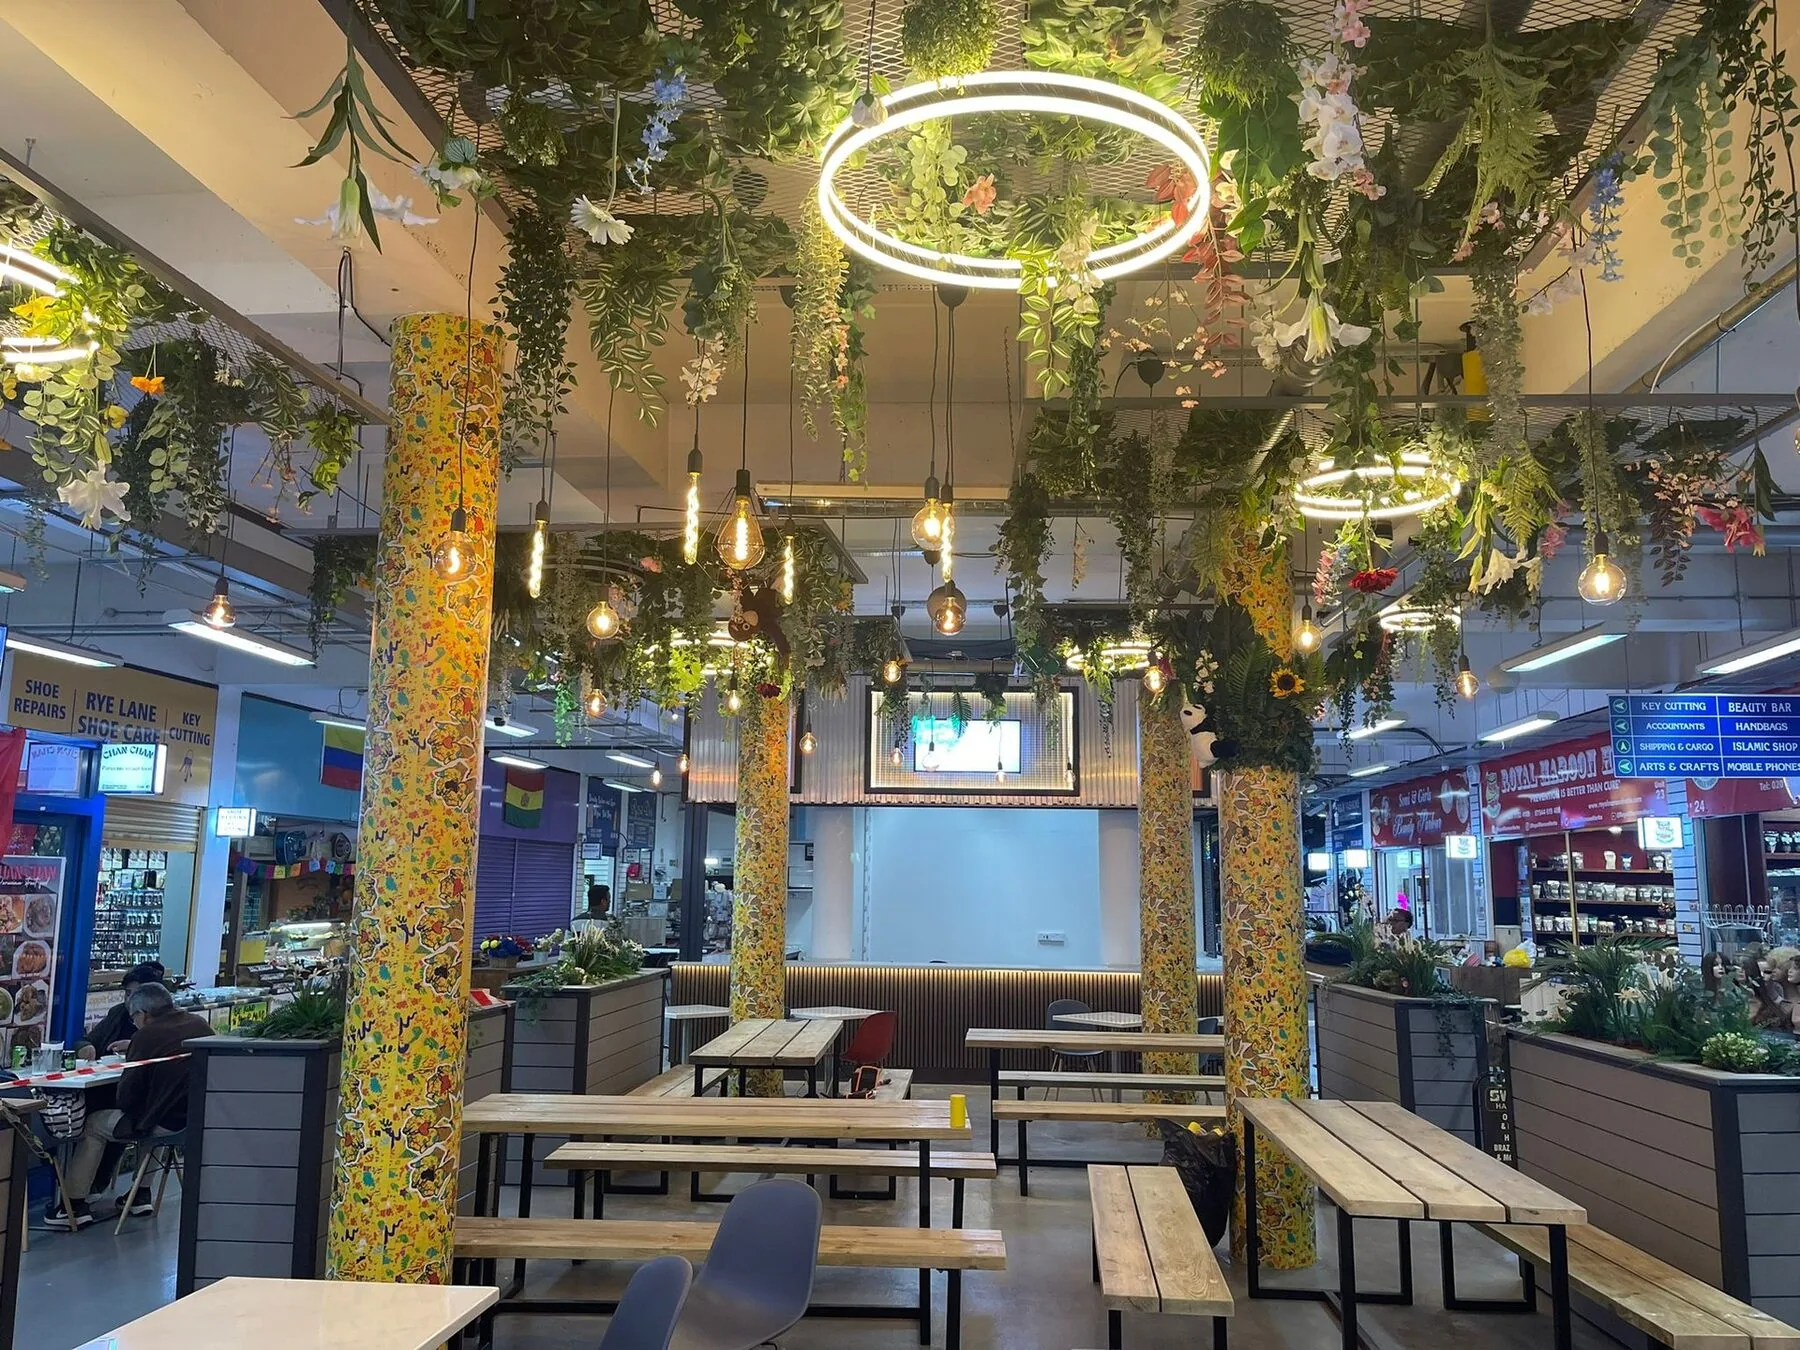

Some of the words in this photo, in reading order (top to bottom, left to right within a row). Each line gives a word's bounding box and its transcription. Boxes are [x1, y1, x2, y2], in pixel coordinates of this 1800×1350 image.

[25, 679, 60, 699] SHOE
[14, 697, 66, 720] REPAIRS
[86, 691, 115, 714] RYE
[119, 698, 157, 722] LANE
[1641, 702, 1661, 711] KEY
[1664, 702, 1707, 711] CUTTING
[1728, 702, 1767, 713] BEAUTY
[1771, 703, 1792, 712] BAR
[182, 711, 201, 727] KEY
[78, 715, 119, 739] SHOE
[123, 723, 160, 743] CARE
[1646, 722, 1705, 731] ACCOUNTANTS
[1735, 722, 1788, 732] HANDBAGS
[169, 727, 211, 746] CUTTING
[103, 746, 128, 760] CHAN
[130, 746, 154, 759] CHAN
[1640, 742, 1676, 751] SHIPPING
[1677, 742, 1685, 751] &
[1685, 742, 1714, 751] CARGO
[1732, 742, 1771, 752] ISLAMIC
[1772, 742, 1798, 752] SHOP
[1501, 763, 1538, 794] ROYAL
[1538, 748, 1598, 787] MAROON
[1639, 762, 1666, 771] ARTS
[1668, 762, 1677, 771] &
[1679, 762, 1720, 771] CRAFTS
[1727, 762, 1763, 772] MOBILE
[1566, 784, 1587, 797] BETTER
[1587, 782, 1604, 794] THAN
[1655, 789, 1665, 800] 23
[1694, 800, 1705, 813] 24
